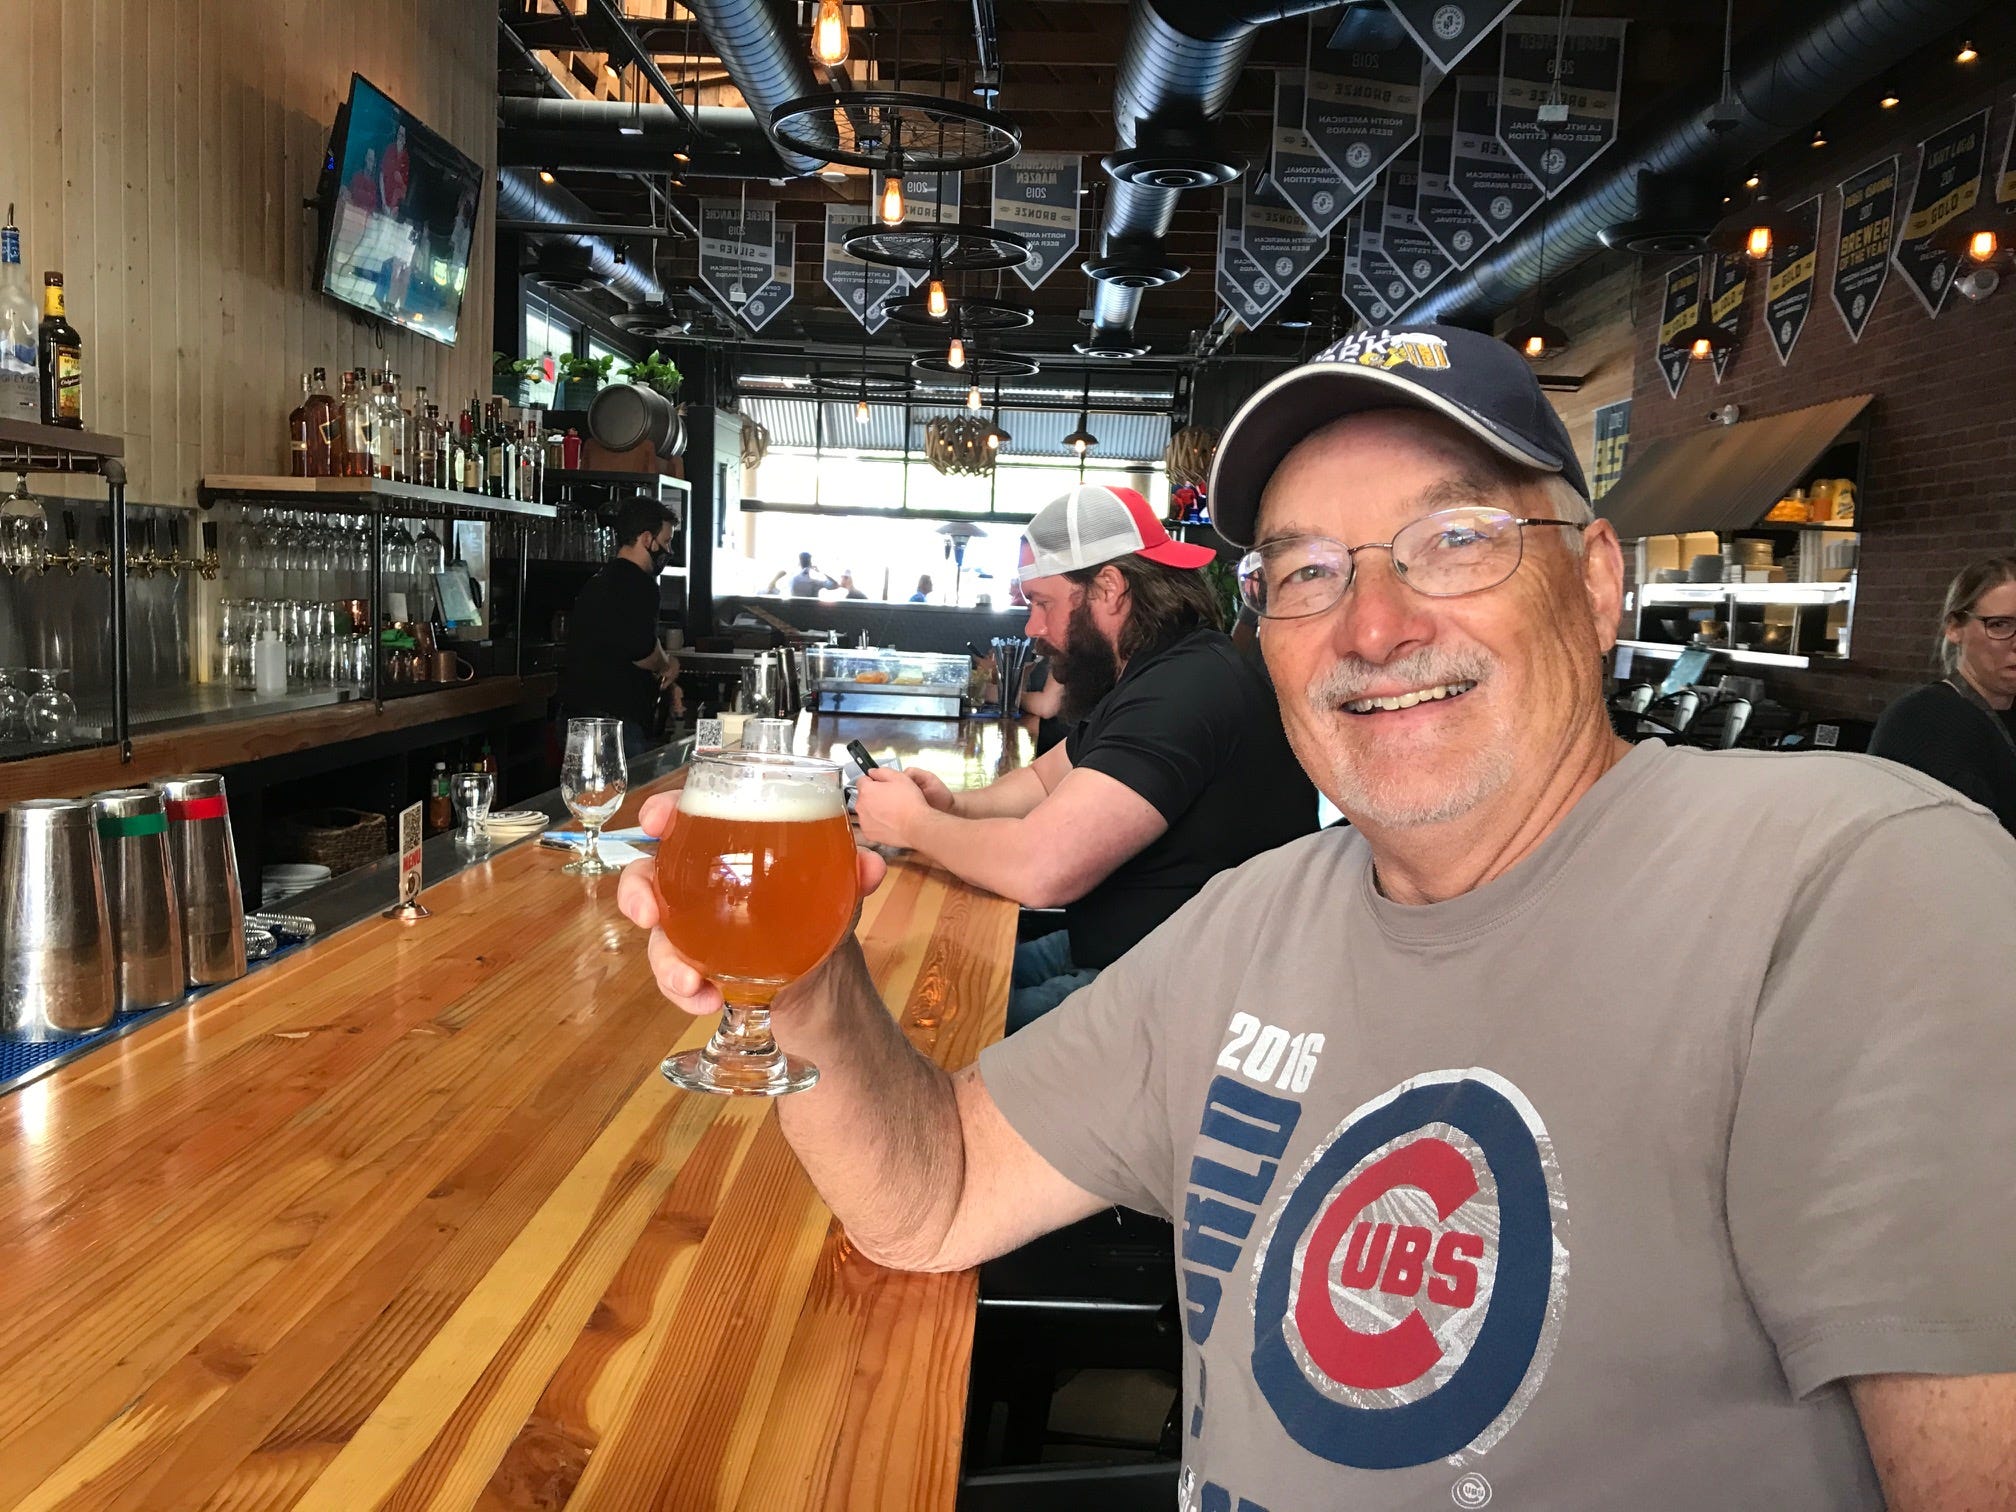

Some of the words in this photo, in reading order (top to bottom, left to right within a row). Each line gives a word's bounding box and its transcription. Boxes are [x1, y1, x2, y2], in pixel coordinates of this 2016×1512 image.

[1931, 193, 1960, 224] GOLD
[1840, 216, 1891, 257] BREWER
[403, 847, 421, 873] MENU
[1216, 1011, 1326, 1093] 2016
[1295, 1137, 1485, 1391] CUBS
